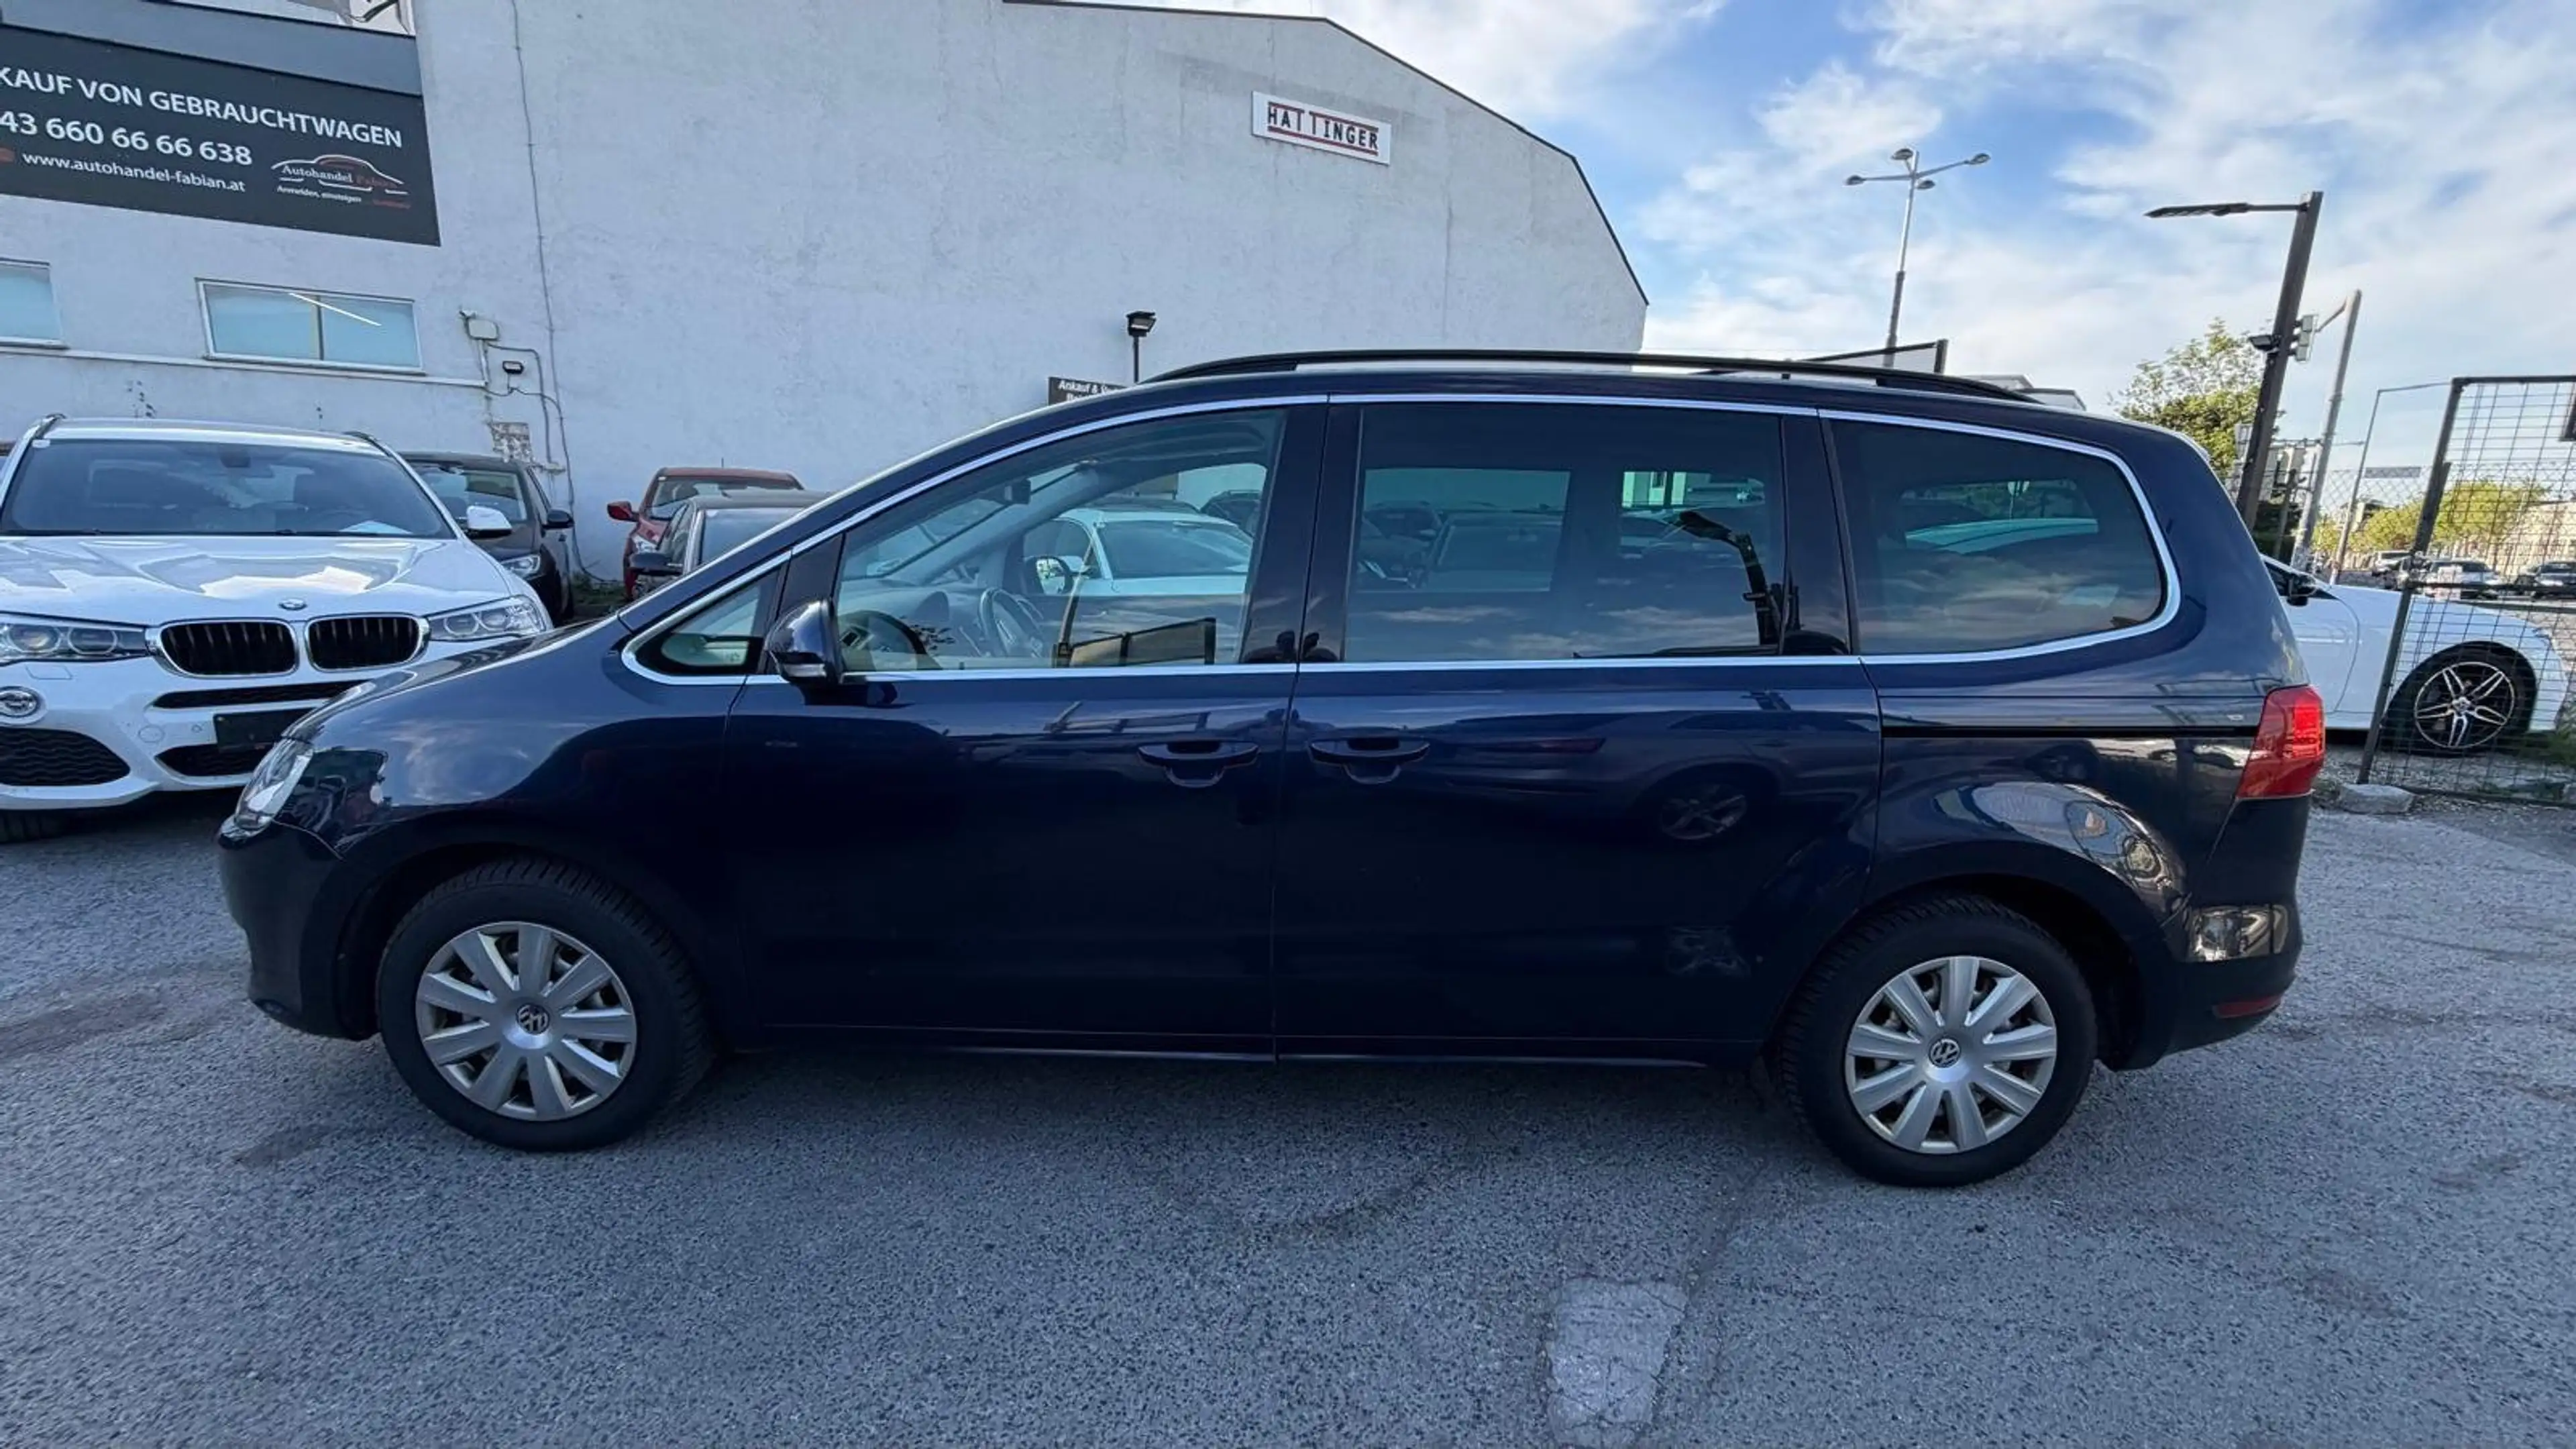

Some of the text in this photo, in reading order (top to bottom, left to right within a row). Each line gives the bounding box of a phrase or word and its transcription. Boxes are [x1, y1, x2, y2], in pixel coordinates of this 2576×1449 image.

[76, 78, 142, 106] VON
[149, 91, 402, 148] GEBRAUCHTWAGEN
[1267, 101, 1379, 150] HATTINGER
[0, 111, 252, 165] 43 660 66 66 638
[22, 152, 246, 192] www.autohandel-fabian.at
[282, 166, 353, 182] Autohandel
